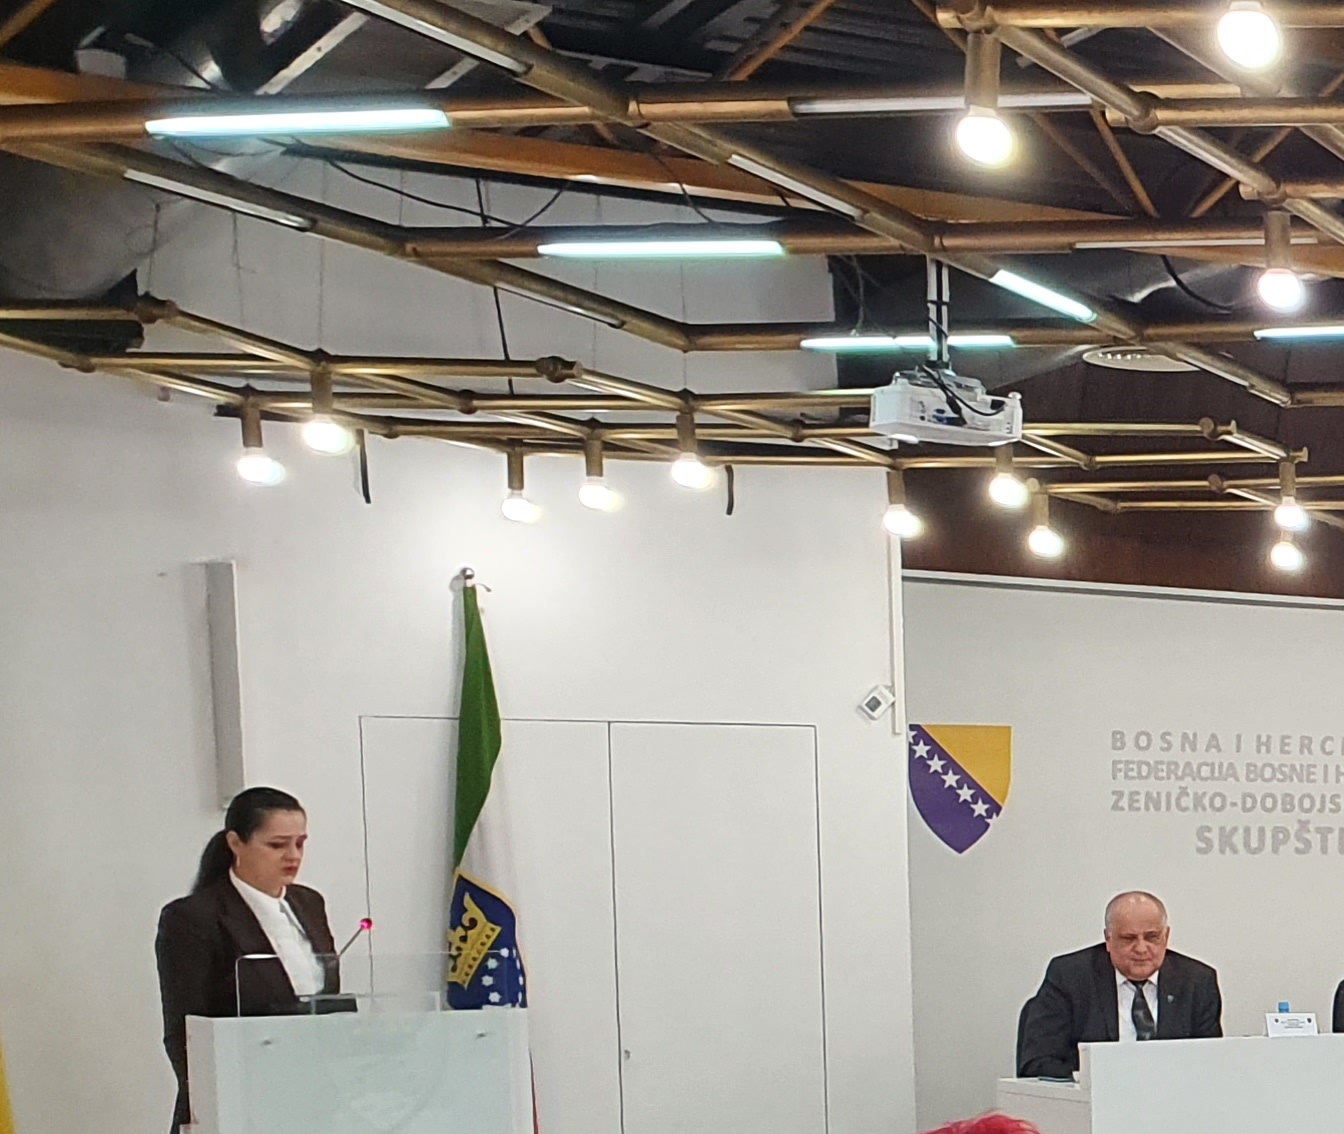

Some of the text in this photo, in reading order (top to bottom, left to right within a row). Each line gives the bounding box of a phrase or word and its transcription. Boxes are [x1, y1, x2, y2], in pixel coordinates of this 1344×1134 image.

[1111, 730, 1223, 754] BOSNA
[1235, 732, 1243, 754] I
[1111, 759, 1241, 783] FEDERACIJA
[1244, 761, 1318, 785] BOSNE
[1323, 763, 1329, 784] I
